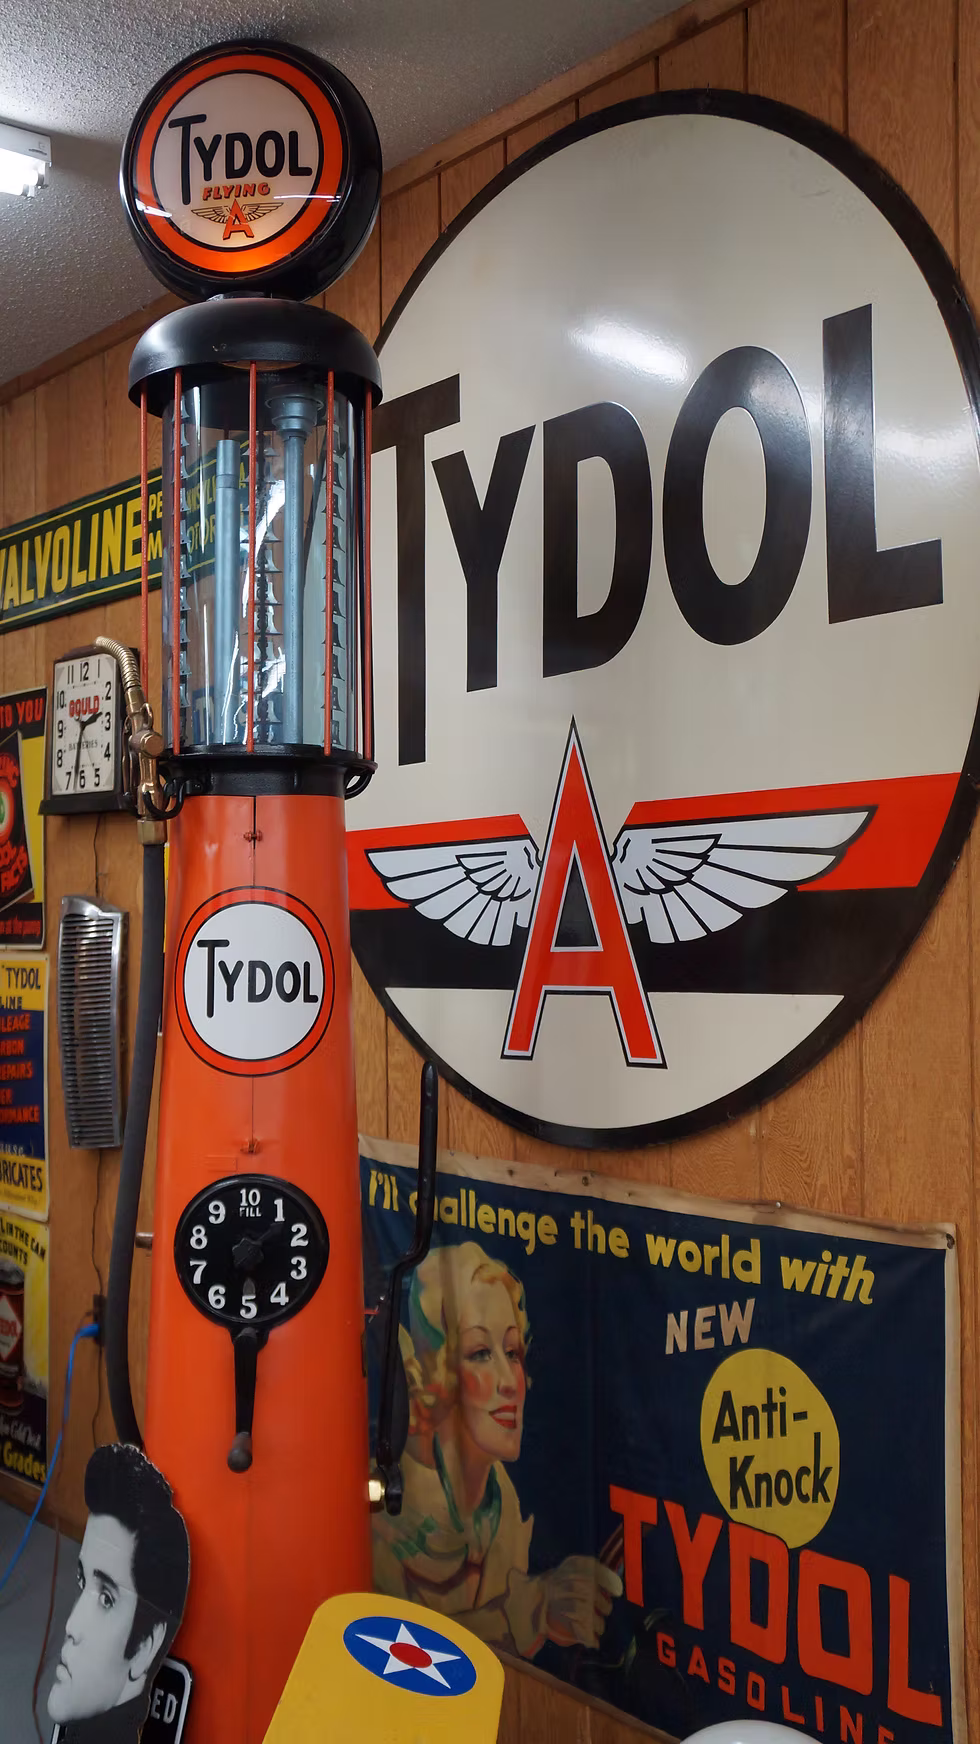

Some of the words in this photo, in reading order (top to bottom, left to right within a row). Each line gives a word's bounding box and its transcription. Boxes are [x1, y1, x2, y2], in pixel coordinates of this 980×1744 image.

[168, 114, 313, 206] TYDOL
[202, 182, 271, 201] FLYING
[223, 199, 255, 240] A
[371, 304, 943, 766] TYDOL
[80, 661, 89, 682] 12
[56, 691, 65, 710] 10
[105, 681, 112, 700] 2
[69, 695, 99, 718] GOULD
[16, 698, 44, 725] YOU
[57, 720, 64, 738] 9
[105, 711, 112, 731] 3
[57, 749, 63, 768] 8
[104, 742, 111, 761] 4
[69, 740, 98, 751] BAERIES
[65, 771, 72, 790] 7
[79, 770, 86, 788] 6
[94, 768, 100, 787] 5
[500, 716, 668, 1069] A
[6, 968, 41, 990] TYDOL
[197, 939, 319, 1018] TYDOL
[0, 1013, 31, 1032] LEAGE
[240, 1188, 260, 1206] 10
[208, 1201, 226, 1224] 9
[274, 1198, 285, 1222] 1
[239, 1207, 261, 1217] FILL
[15, 1226, 29, 1246] THE
[30, 1238, 46, 1262] CAN
[190, 1225, 208, 1249] 8
[290, 1224, 308, 1247] 2
[409, 1188, 558, 1255] callenge
[570, 1210, 630, 1258] the
[645, 1233, 762, 1285] world
[780, 1250, 876, 1305] with
[190, 1261, 207, 1284] 7
[290, 1256, 307, 1280] 3
[208, 1285, 226, 1309] 6
[270, 1282, 289, 1306] 4
[240, 1295, 258, 1319] 5
[665, 1298, 756, 1355] NEW
[712, 1387, 809, 1445] Anti-
[3, 1441, 45, 1483] Grades
[729, 1431, 833, 1509] Knock
[609, 1484, 943, 1727] TYDOL
[150, 1687, 178, 1724] ED
